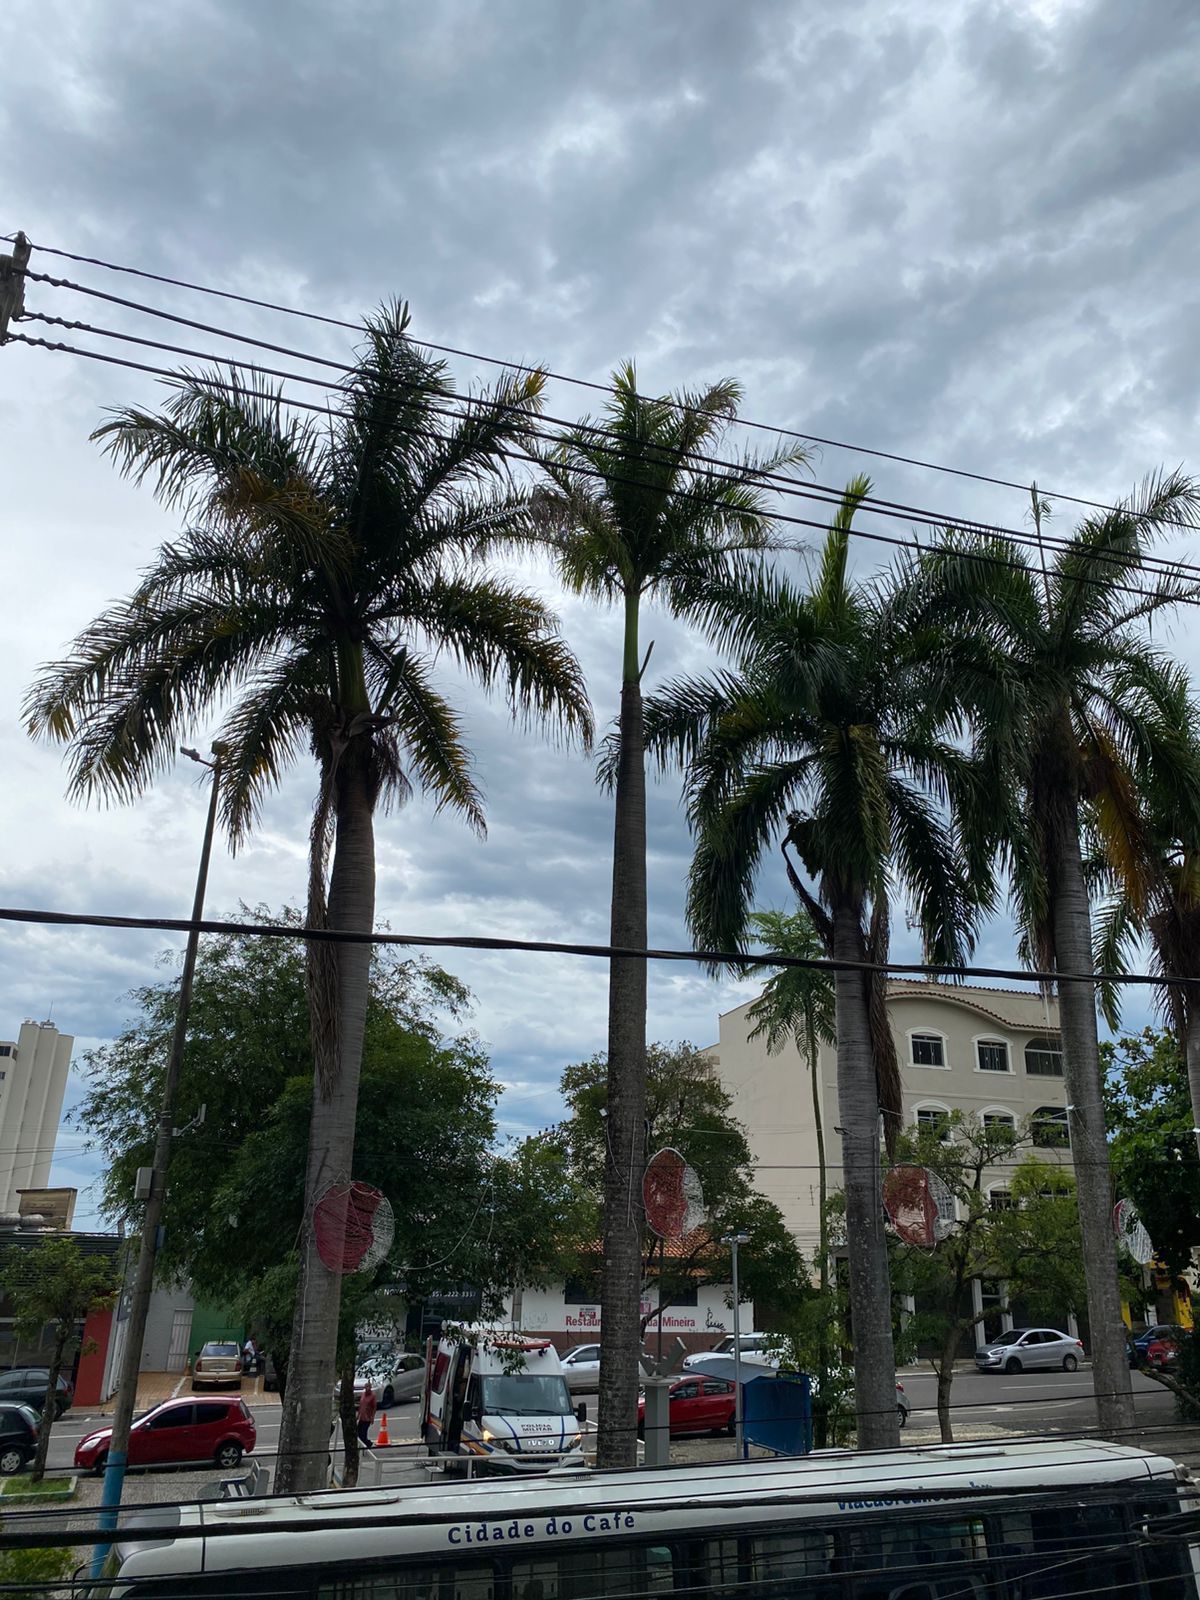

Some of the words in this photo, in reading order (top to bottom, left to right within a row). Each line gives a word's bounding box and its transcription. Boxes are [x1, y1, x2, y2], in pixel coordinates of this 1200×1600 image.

[565, 1315, 601, 1327] Restaur
[662, 1315, 696, 1327] Mineira
[448, 1521, 535, 1544] Cidade
[546, 1518, 573, 1535] do
[583, 1512, 635, 1532] Café
